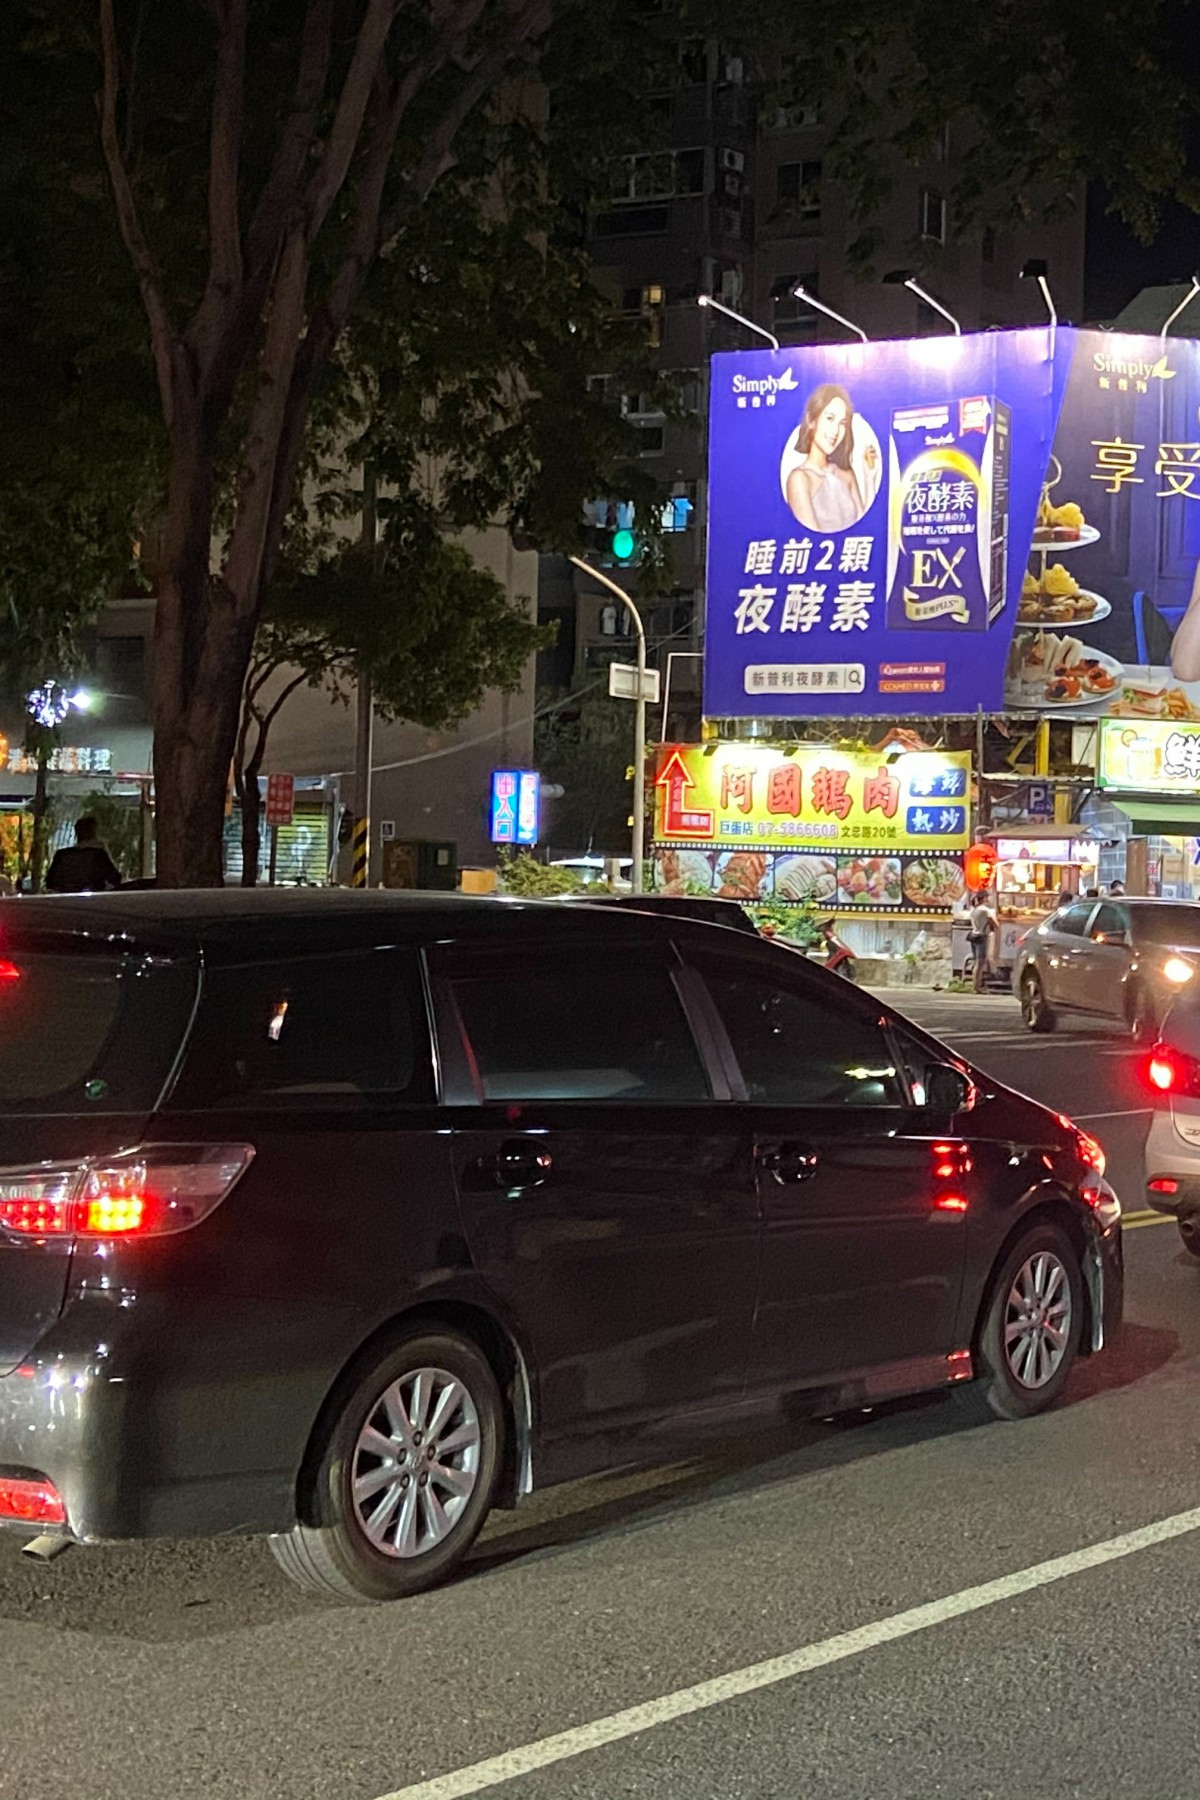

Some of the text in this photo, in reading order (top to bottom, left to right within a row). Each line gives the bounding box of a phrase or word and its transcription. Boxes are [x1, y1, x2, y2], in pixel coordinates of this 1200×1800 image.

[1093, 352, 1154, 380] Simply
[732, 374, 781, 396] Simply
[905, 480, 975, 513] 夜酵素
[743, 536, 874, 575] 睡前2顆
[909, 546, 967, 590] EX
[733, 580, 876, 635] 夜酵素
[752, 671, 839, 687] 新普利夜酵素
[497, 775, 514, 839] 出入口
[720, 762, 902, 820] 阿國鵝肉
[1030, 787, 1045, 809] P
